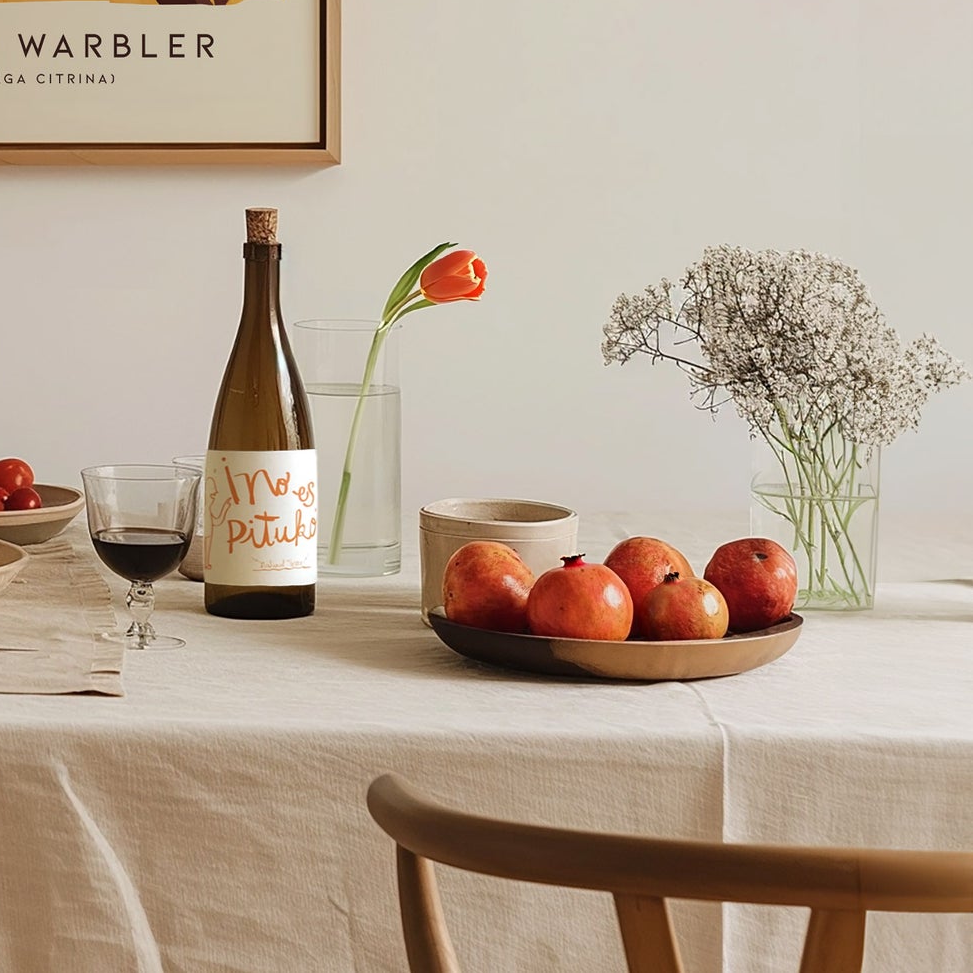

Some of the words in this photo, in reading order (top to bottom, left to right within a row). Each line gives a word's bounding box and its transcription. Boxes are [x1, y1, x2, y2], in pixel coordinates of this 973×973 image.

[17, 33, 216, 59] WARBLER
[35, 73, 116, 85] CITRINA)
[292, 481, 315, 507] es
